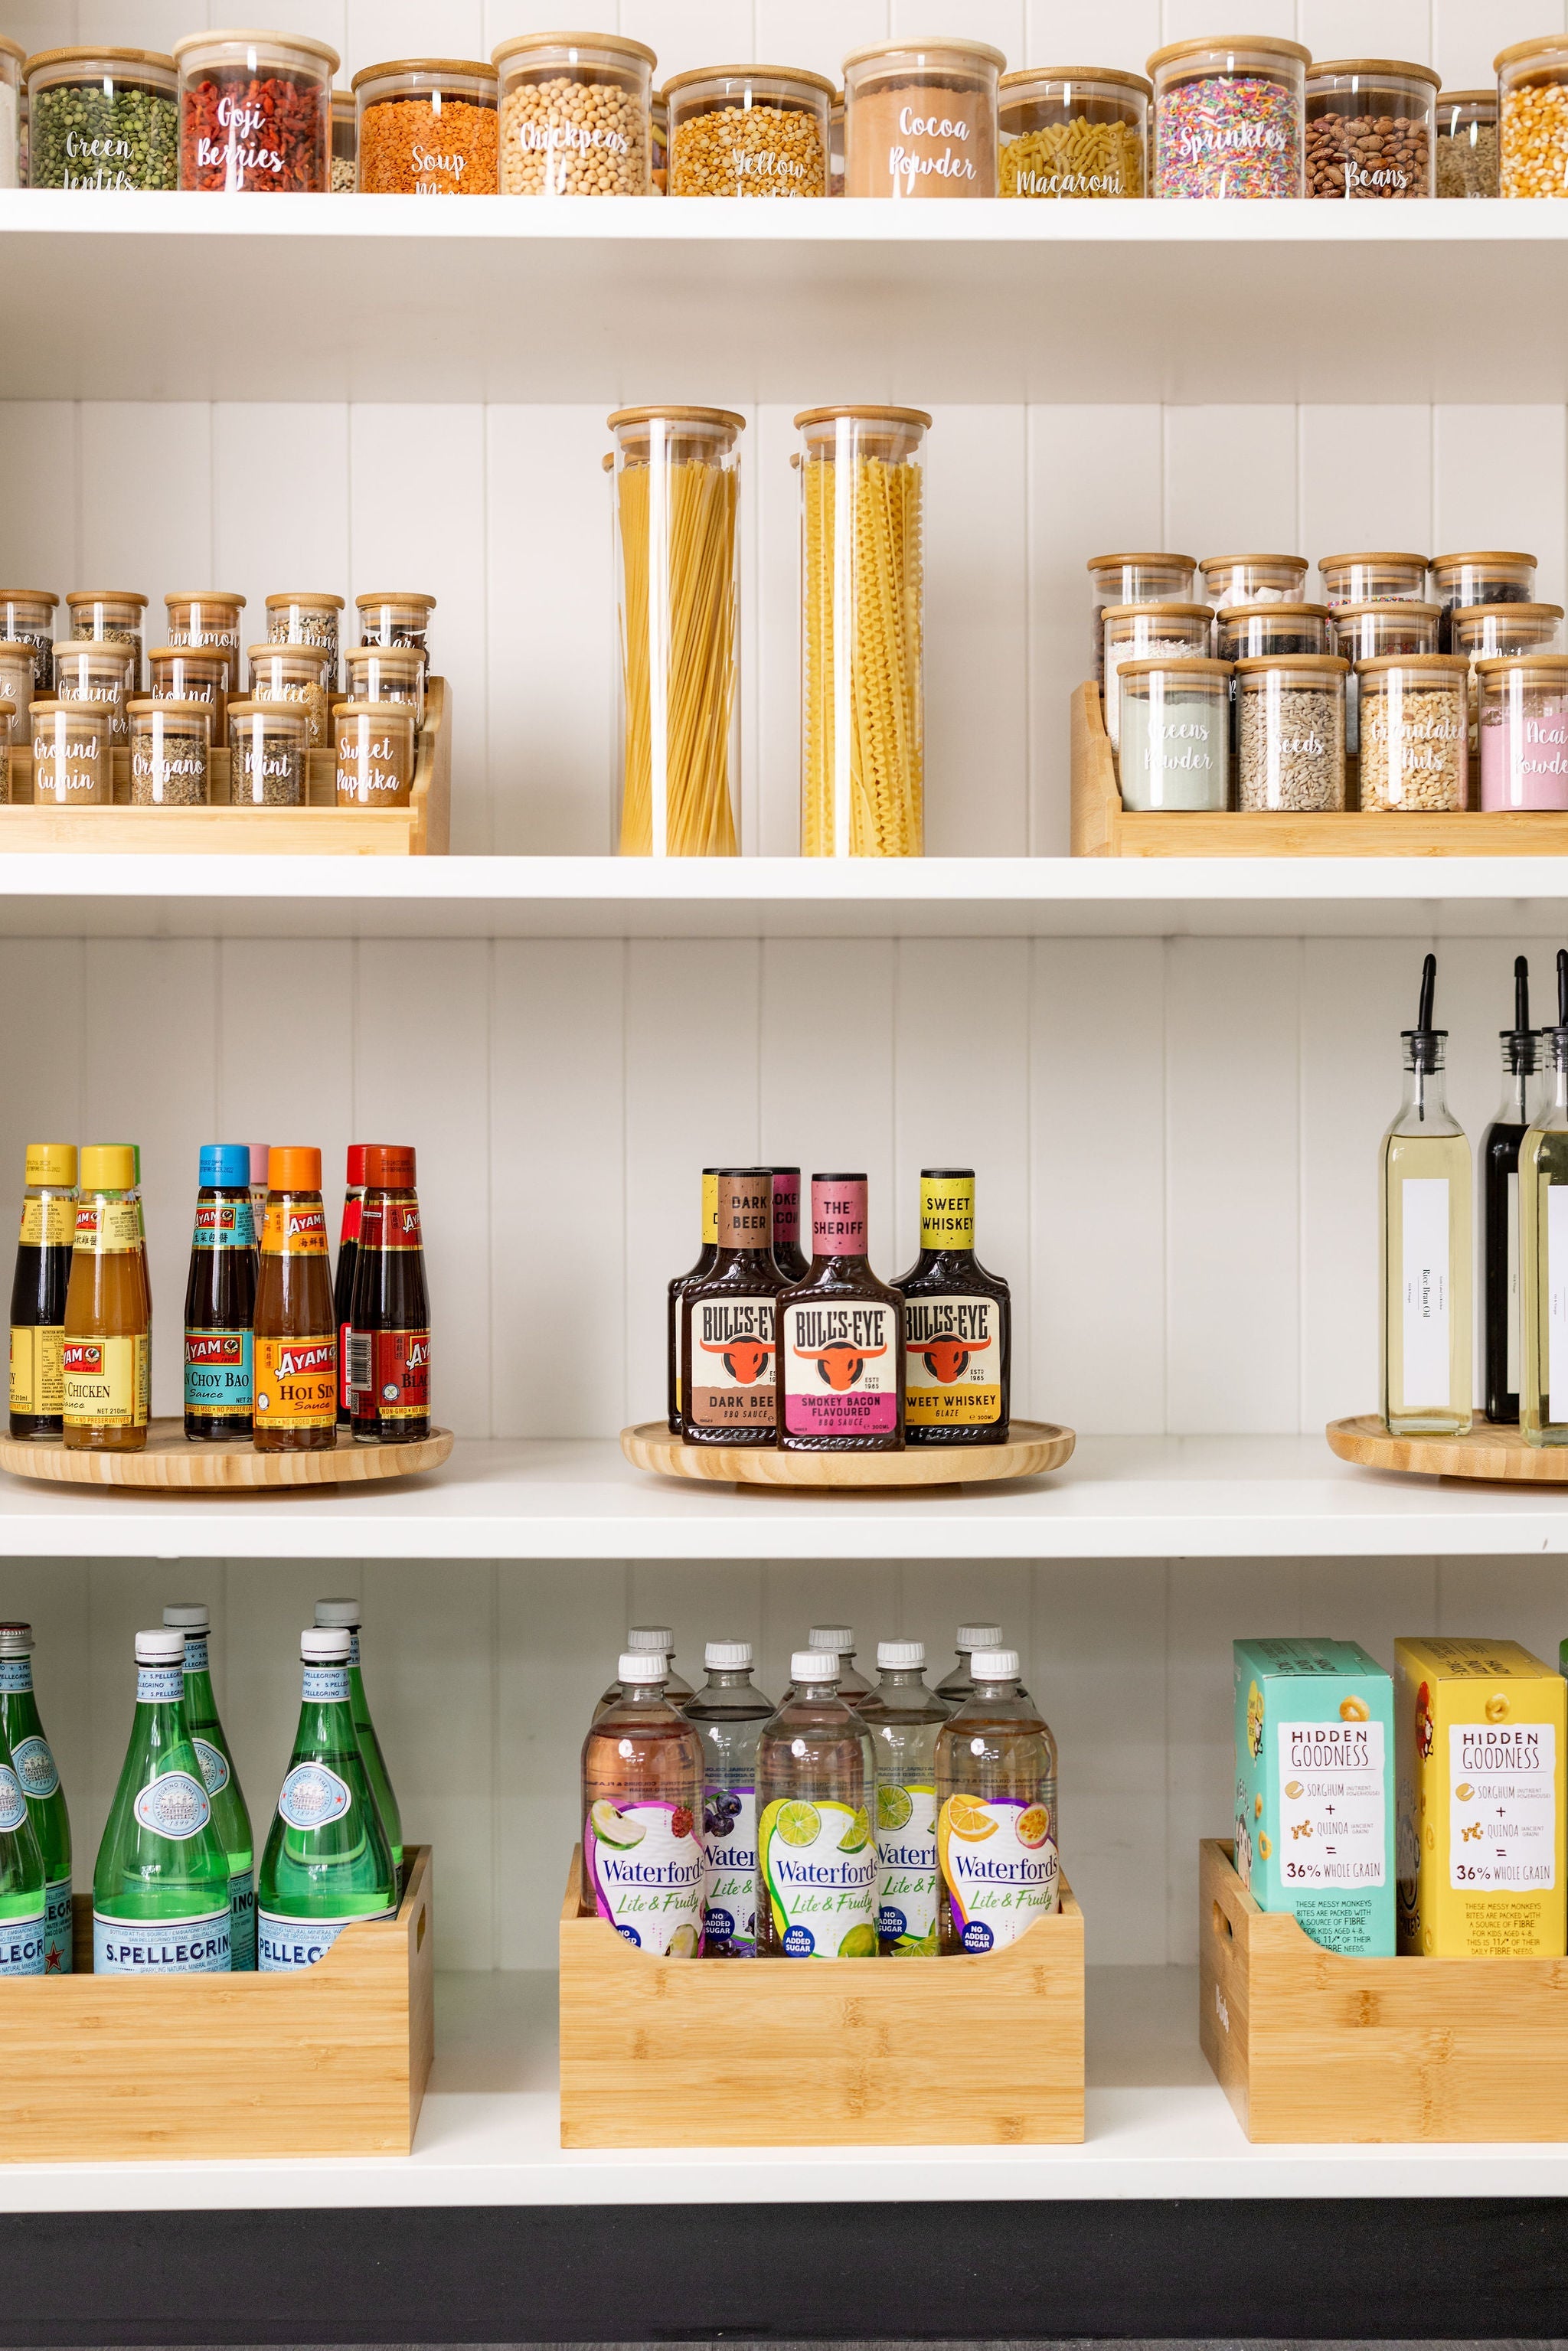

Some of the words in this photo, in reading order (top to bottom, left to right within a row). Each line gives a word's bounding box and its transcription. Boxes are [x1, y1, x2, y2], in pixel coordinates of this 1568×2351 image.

[217, 96, 266, 139] Goji
[900, 106, 970, 141] Cocoa
[66, 131, 134, 159] Green
[520, 121, 630, 158] Chickpeas
[1180, 120, 1288, 163] Sprinkles
[198, 137, 286, 173] Berries
[411, 145, 468, 181] Soup
[731, 148, 808, 178] Yellow
[888, 146, 977, 181] Powder
[1016, 170, 1125, 196] Macaroni
[1344, 161, 1409, 190] Beans
[167, 626, 240, 649] Cinnamon
[58, 680, 121, 704] Ground
[1147, 717, 1210, 743] Greens
[1371, 717, 1468, 742] Granulated
[34, 736, 100, 761] Ground
[340, 737, 394, 761] Sweet
[1144, 746, 1214, 771] Powder
[1401, 746, 1446, 772] Nuts
[132, 753, 205, 783] Oregano
[245, 751, 292, 778] Mint
[1514, 751, 1568, 776] Powde
[38, 766, 95, 790] Cumin
[336, 768, 400, 798] Paprika
[732, 1196, 767, 1209] DARK
[824, 1201, 851, 1214] THE
[926, 1197, 971, 1210] SWEET
[194, 1210, 220, 1232] AYAM
[286, 1213, 321, 1238] AYAM
[733, 1216, 766, 1229] BEER
[814, 1221, 864, 1235] SHERIFF
[922, 1217, 974, 1230] WHISKEY
[1423, 1269, 1431, 1285] Rice
[1423, 1287, 1431, 1304] Bran
[906, 1304, 988, 1341] BULL'S-EYE
[1423, 1305, 1431, 1318] Oil
[703, 1306, 776, 1341] BULL'S-EY
[795, 1311, 884, 1347] BULL'S-EYE
[184, 1340, 221, 1365] AYAM
[273, 1347, 328, 1381] AYAM
[67, 1381, 111, 1399] CHICKEN
[191, 1371, 222, 1387] CHOY
[224, 1372, 250, 1387] BAO
[189, 1388, 224, 1399] Sauce
[279, 1385, 313, 1400] HOI
[709, 1396, 744, 1408] DARK
[750, 1396, 775, 1408] BEE
[802, 1397, 843, 1406] SMOKEY
[847, 1396, 881, 1406] BACON
[906, 1396, 940, 1407] WEET
[943, 1395, 997, 1406] WHISKEY
[293, 1402, 331, 1411] Sauce
[724, 1410, 740, 1419] BBQ
[743, 1409, 768, 1419] SAUCE
[812, 1406, 871, 1416] FLAVOURED
[818, 1418, 835, 1426] BBQ
[838, 1418, 864, 1426] SAUCE
[1292, 1730, 1367, 1743] HIDDEN
[1463, 1732, 1538, 1745] HIDDEN
[1292, 1745, 1369, 1767] GOODNESS
[1462, 1747, 1540, 1769] GOODNESS
[180, 1782, 194, 1796] TERME
[1306, 1783, 1344, 1797] SORGHUM
[1477, 1785, 1516, 1799] SORGHUM
[1317, 1821, 1348, 1837] QUINOA
[1487, 1824, 1519, 1839] QUINOA
[603, 1853, 706, 1884] Waterfords
[776, 1857, 880, 1885] Waterfords
[955, 1853, 1058, 1881] Waterfords
[1286, 1863, 1321, 1878] 36%
[1323, 1864, 1351, 1878] WHOLE
[1352, 1863, 1381, 1878] GRAIN
[1456, 1865, 1491, 1880] 36%
[1493, 1866, 1521, 1881] WHOLE
[1522, 1865, 1550, 1880] GRAIN
[709, 1878, 740, 1898] Lite
[741, 1879, 753, 1892] &
[881, 1876, 911, 1896] Lite
[913, 1879, 925, 1892] &
[616, 1893, 649, 1914] Lite
[648, 1896, 660, 1909] &
[663, 1889, 700, 1912] Fruity
[790, 1893, 822, 1914] Lite
[822, 1896, 834, 1910] &
[836, 1889, 873, 1913] Fruity
[969, 1889, 1001, 1910] Lite
[1001, 1892, 1012, 1905] &
[1015, 1886, 1053, 1910] Fruity
[1341, 1899, 1373, 1908] MONKEYS
[704, 1919, 731, 1928] ADDED
[705, 1926, 731, 1935] SUGAR
[878, 1918, 903, 1926] ADDED
[971, 1925, 984, 1934] NO
[1344, 1917, 1366, 1925] FIBRE
[106, 1933, 230, 1964] S.PELLEGRIN
[786, 1944, 812, 1953] SUGAR
[965, 1939, 990, 1948] SUGAR
